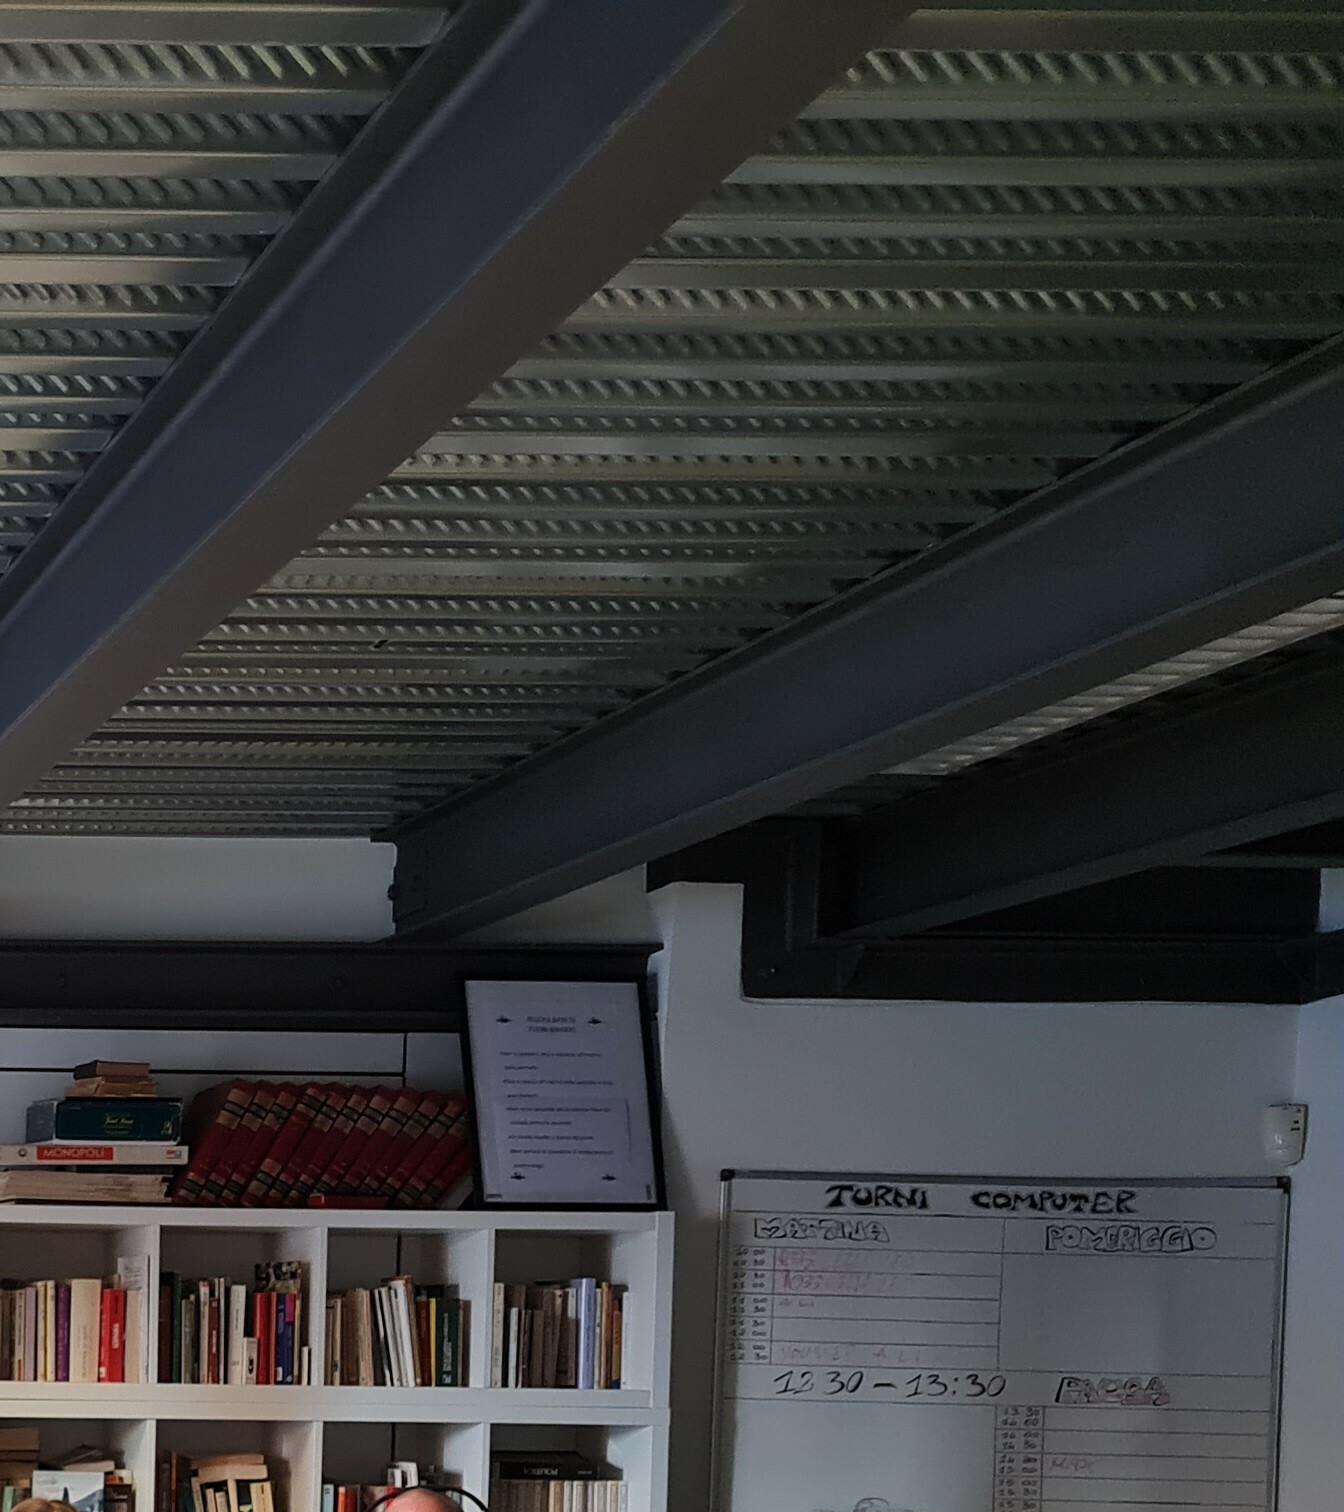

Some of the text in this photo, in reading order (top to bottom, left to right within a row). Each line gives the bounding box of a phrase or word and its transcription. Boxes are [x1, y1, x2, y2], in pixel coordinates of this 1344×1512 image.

[42, 1147, 106, 1158] MONOPOLI
[824, 1184, 1139, 1215] TURNI COMPUTER
[1044, 1224, 1218, 1253] POMERIGGIO
[905, 1373, 1008, 1398] 13:30
